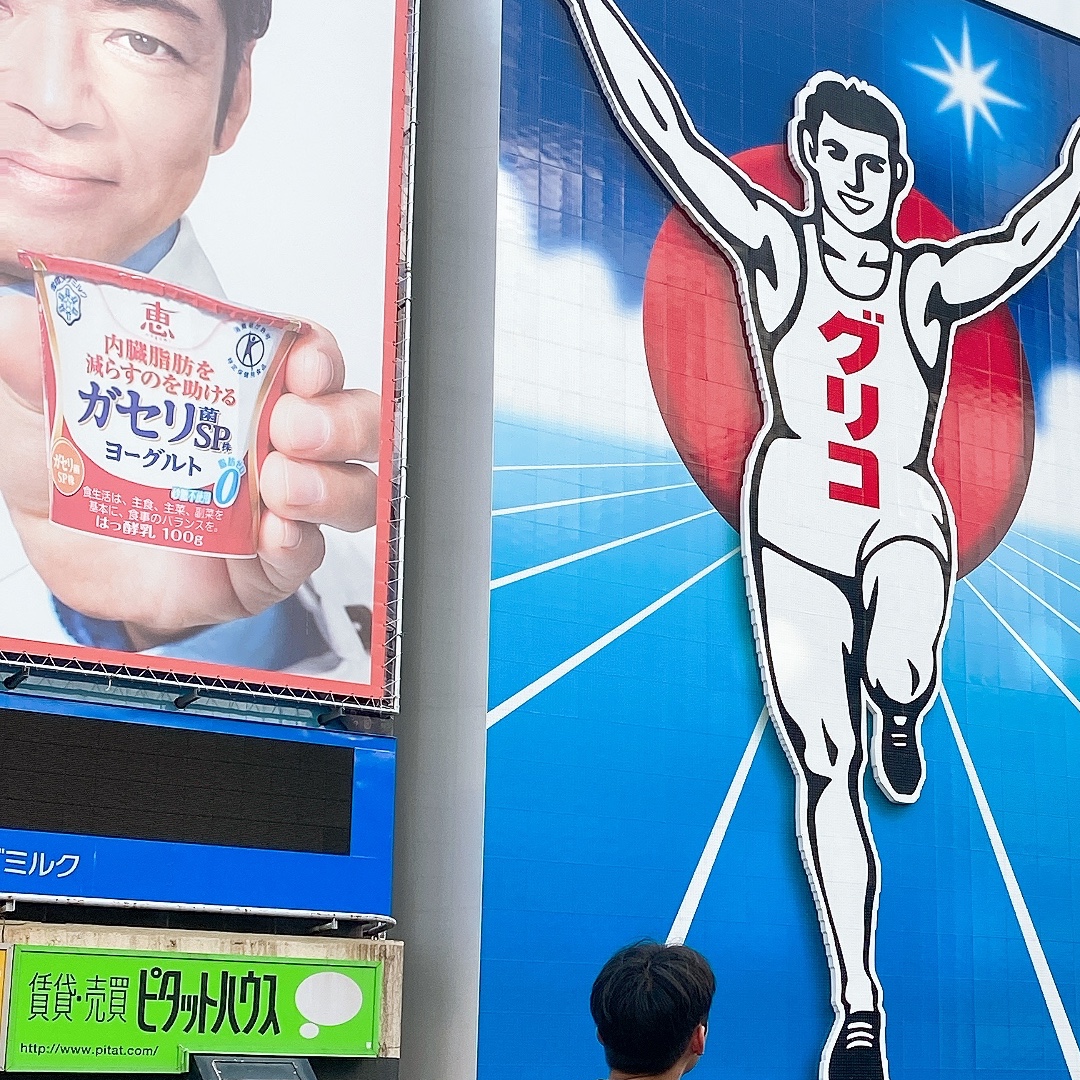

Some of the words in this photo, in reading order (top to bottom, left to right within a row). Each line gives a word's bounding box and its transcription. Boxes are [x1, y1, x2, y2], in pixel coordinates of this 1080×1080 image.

[140, 301, 175, 339] 恵
[85, 353, 237, 407] 減らすのを助ける
[104, 333, 216, 382] 内臓脂肪を
[77, 380, 197, 444] ガセリ
[199, 406, 220, 424] 菌
[818, 309, 885, 509] グリコ
[104, 440, 202, 477] ヨーグルト
[95, 515, 156, 540] はっ酵乳
[162, 527, 204, 547] 100g
[27, 972, 129, 1023] 賃貸・売買
[138, 967, 281, 1036] ピタットハウス
[20, 1042, 159, 1057] http://www.pitat.com/
